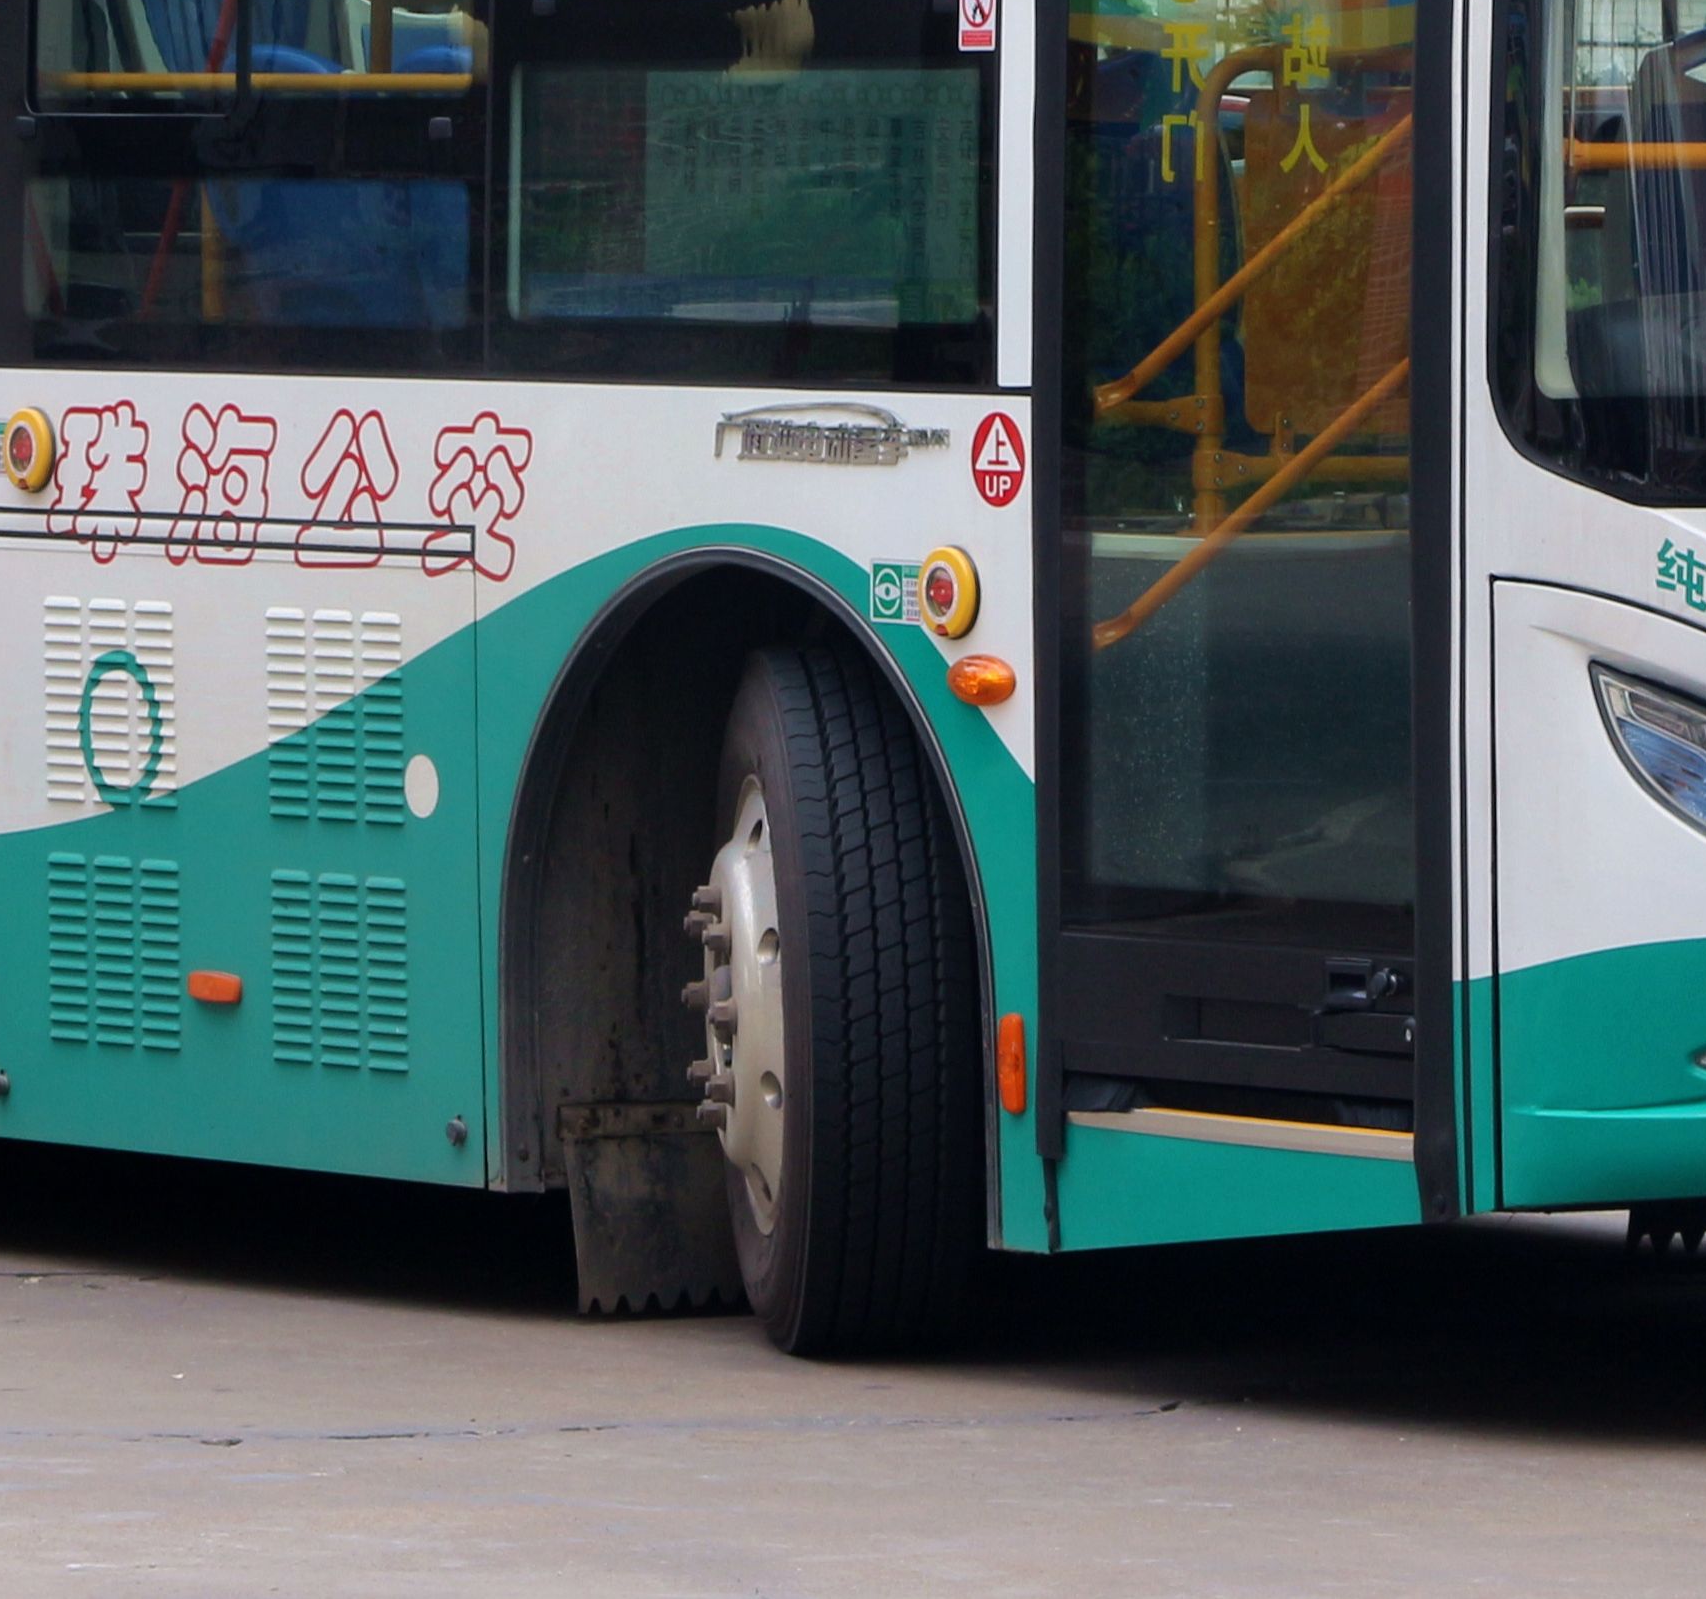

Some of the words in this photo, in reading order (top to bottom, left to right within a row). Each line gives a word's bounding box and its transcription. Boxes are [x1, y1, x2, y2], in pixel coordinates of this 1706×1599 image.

[986, 422, 1010, 466] 上
[46, 399, 533, 582] 珠海公交
[984, 475, 1012, 499] UP
